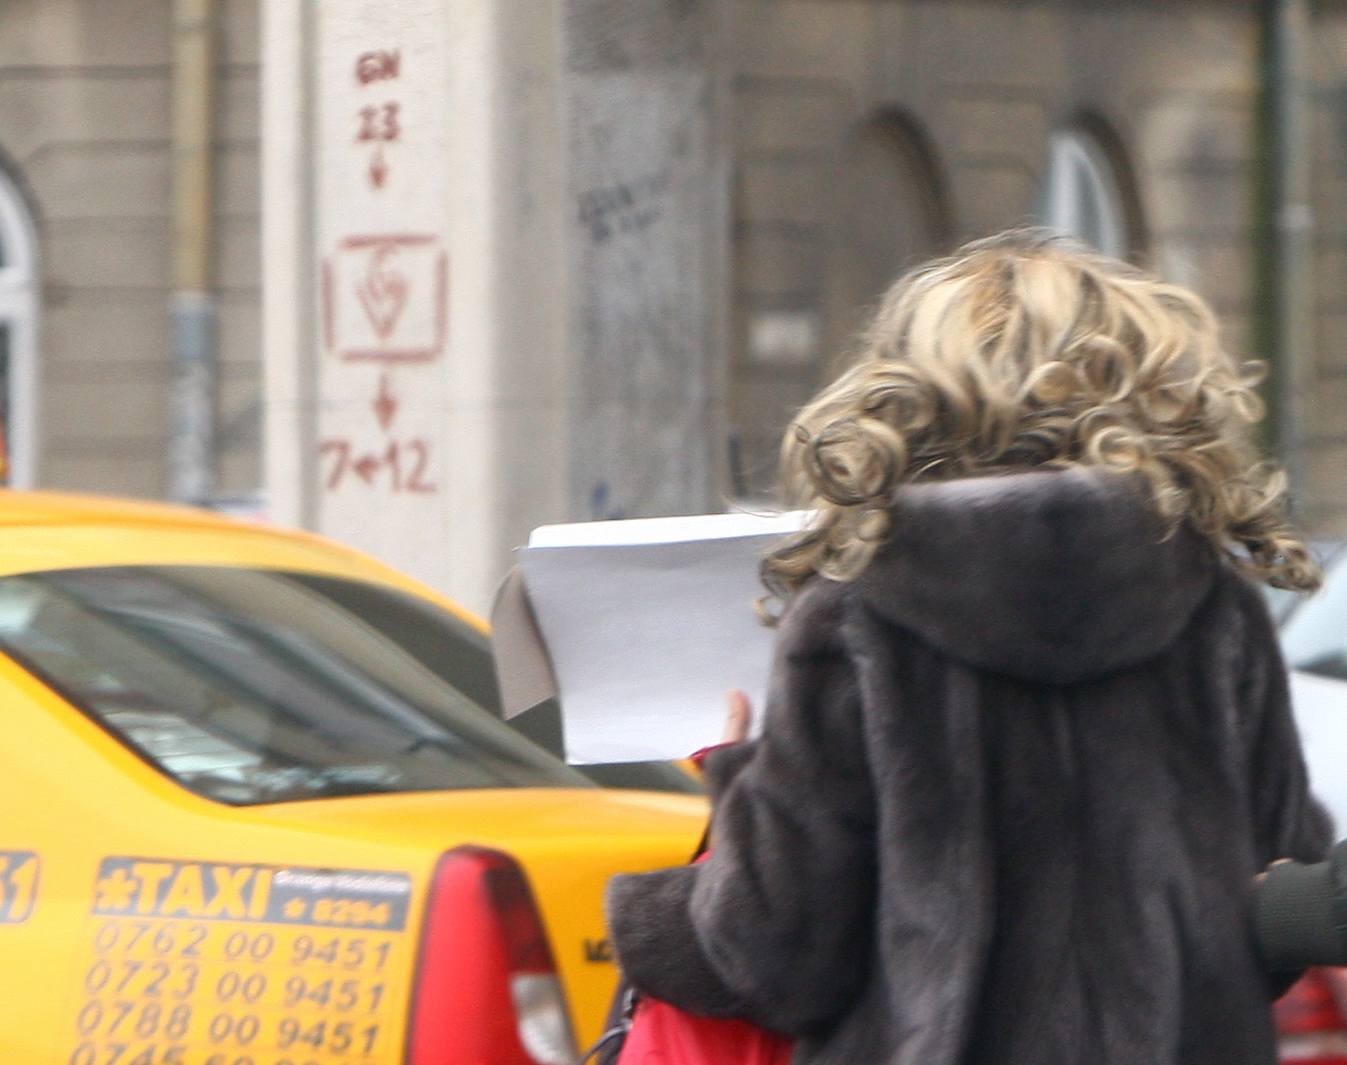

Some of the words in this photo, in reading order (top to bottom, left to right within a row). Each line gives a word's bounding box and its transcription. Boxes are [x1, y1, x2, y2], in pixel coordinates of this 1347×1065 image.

[95, 921, 208, 959] 0762
[224, 931, 275, 962] 00
[291, 935, 392, 973] 9451
[85, 960, 200, 999] 0723
[215, 971, 268, 1004] 00
[284, 976, 385, 1014] 9451
[76, 1000, 193, 1041] 0788
[208, 1012, 261, 1046] 00
[278, 1016, 380, 1056] 9451
